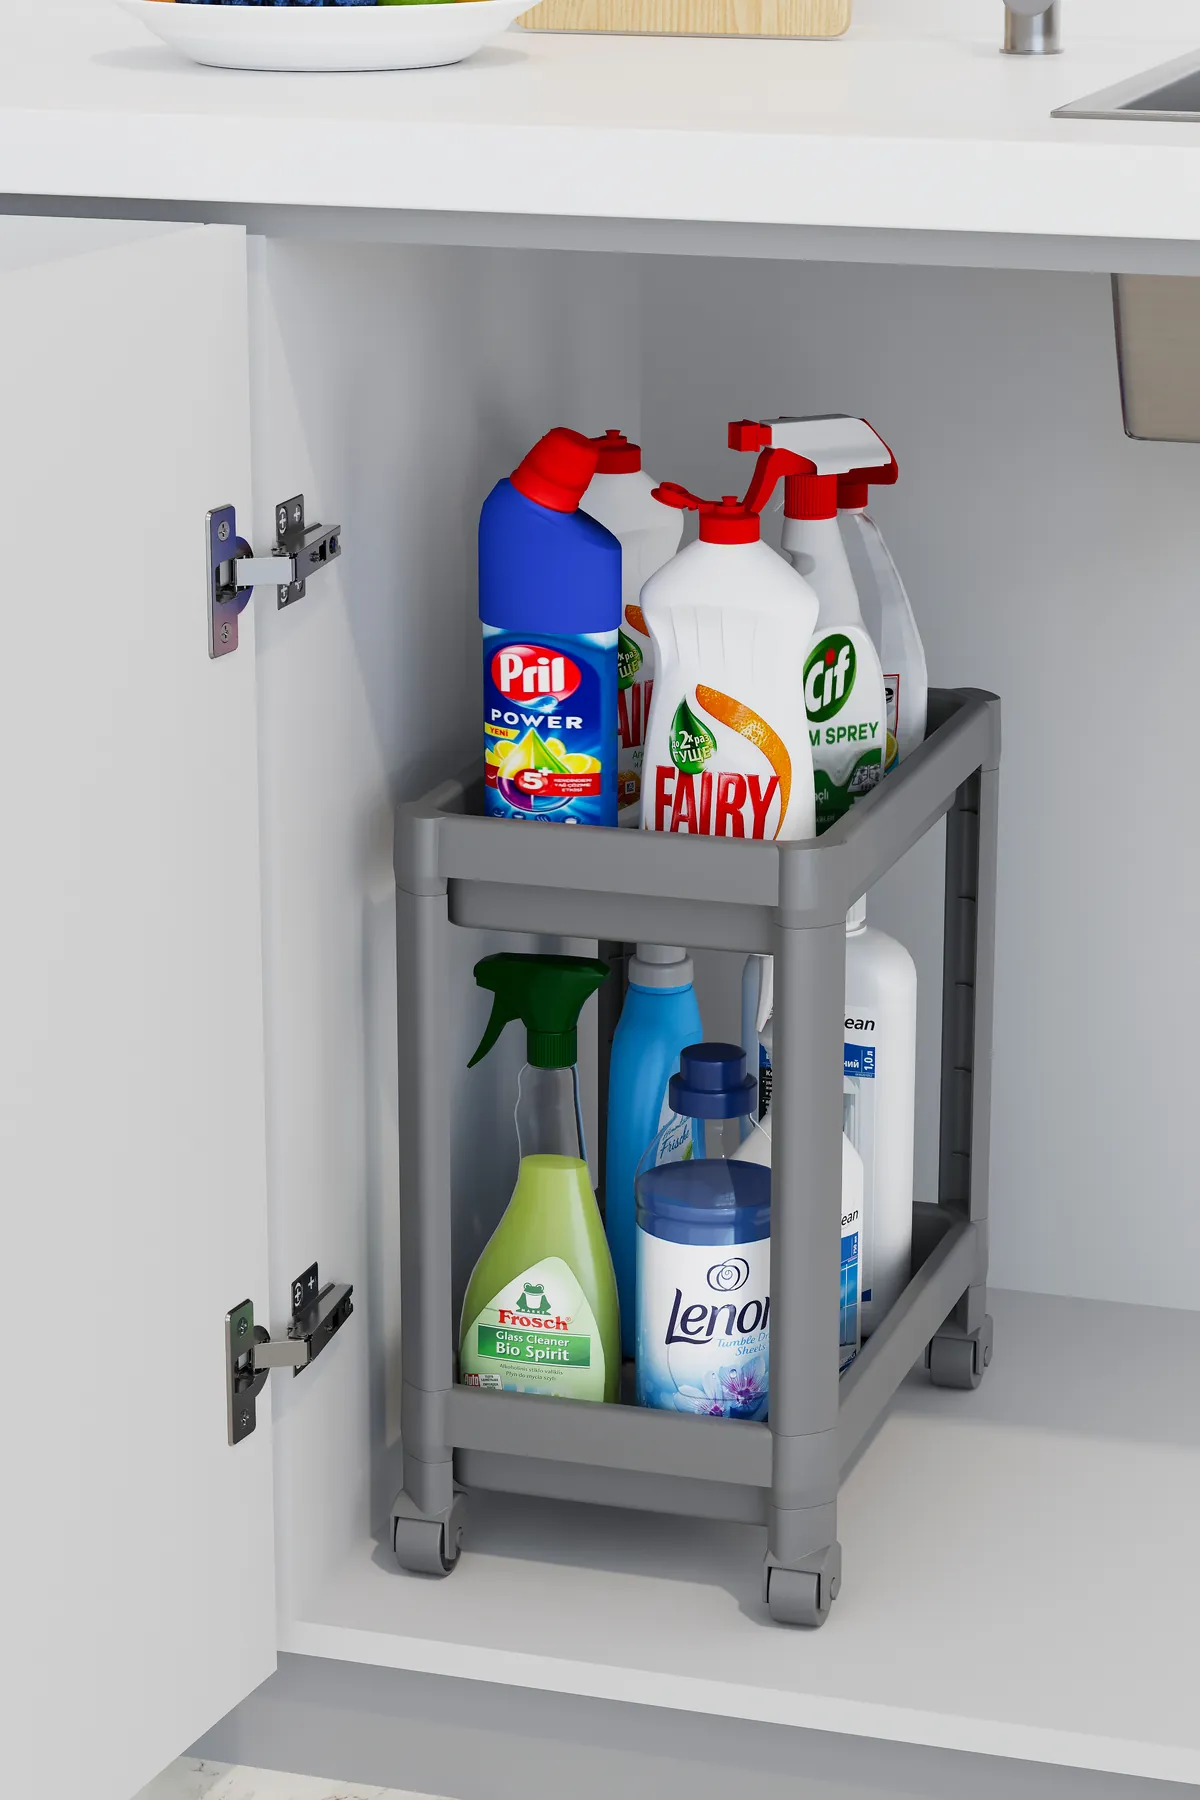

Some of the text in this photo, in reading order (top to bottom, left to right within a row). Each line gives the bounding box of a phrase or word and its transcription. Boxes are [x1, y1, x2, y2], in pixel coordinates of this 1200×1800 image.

[500, 653, 565, 693] Pril
[805, 644, 850, 713] Cif
[491, 708, 583, 729] POWER
[694, 734, 711, 746] раз
[826, 721, 879, 745] SPREY
[672, 746, 712, 763] ГУЩЕ
[655, 765, 781, 839] FAIRY
[498, 1309, 568, 1331] Frosch
[496, 1331, 570, 1347] Glass Cleaner
[718, 1332, 770, 1348] Tumble Dr
[496, 1342, 570, 1362] Bio Spirit
[735, 1343, 766, 1357] Sheets
